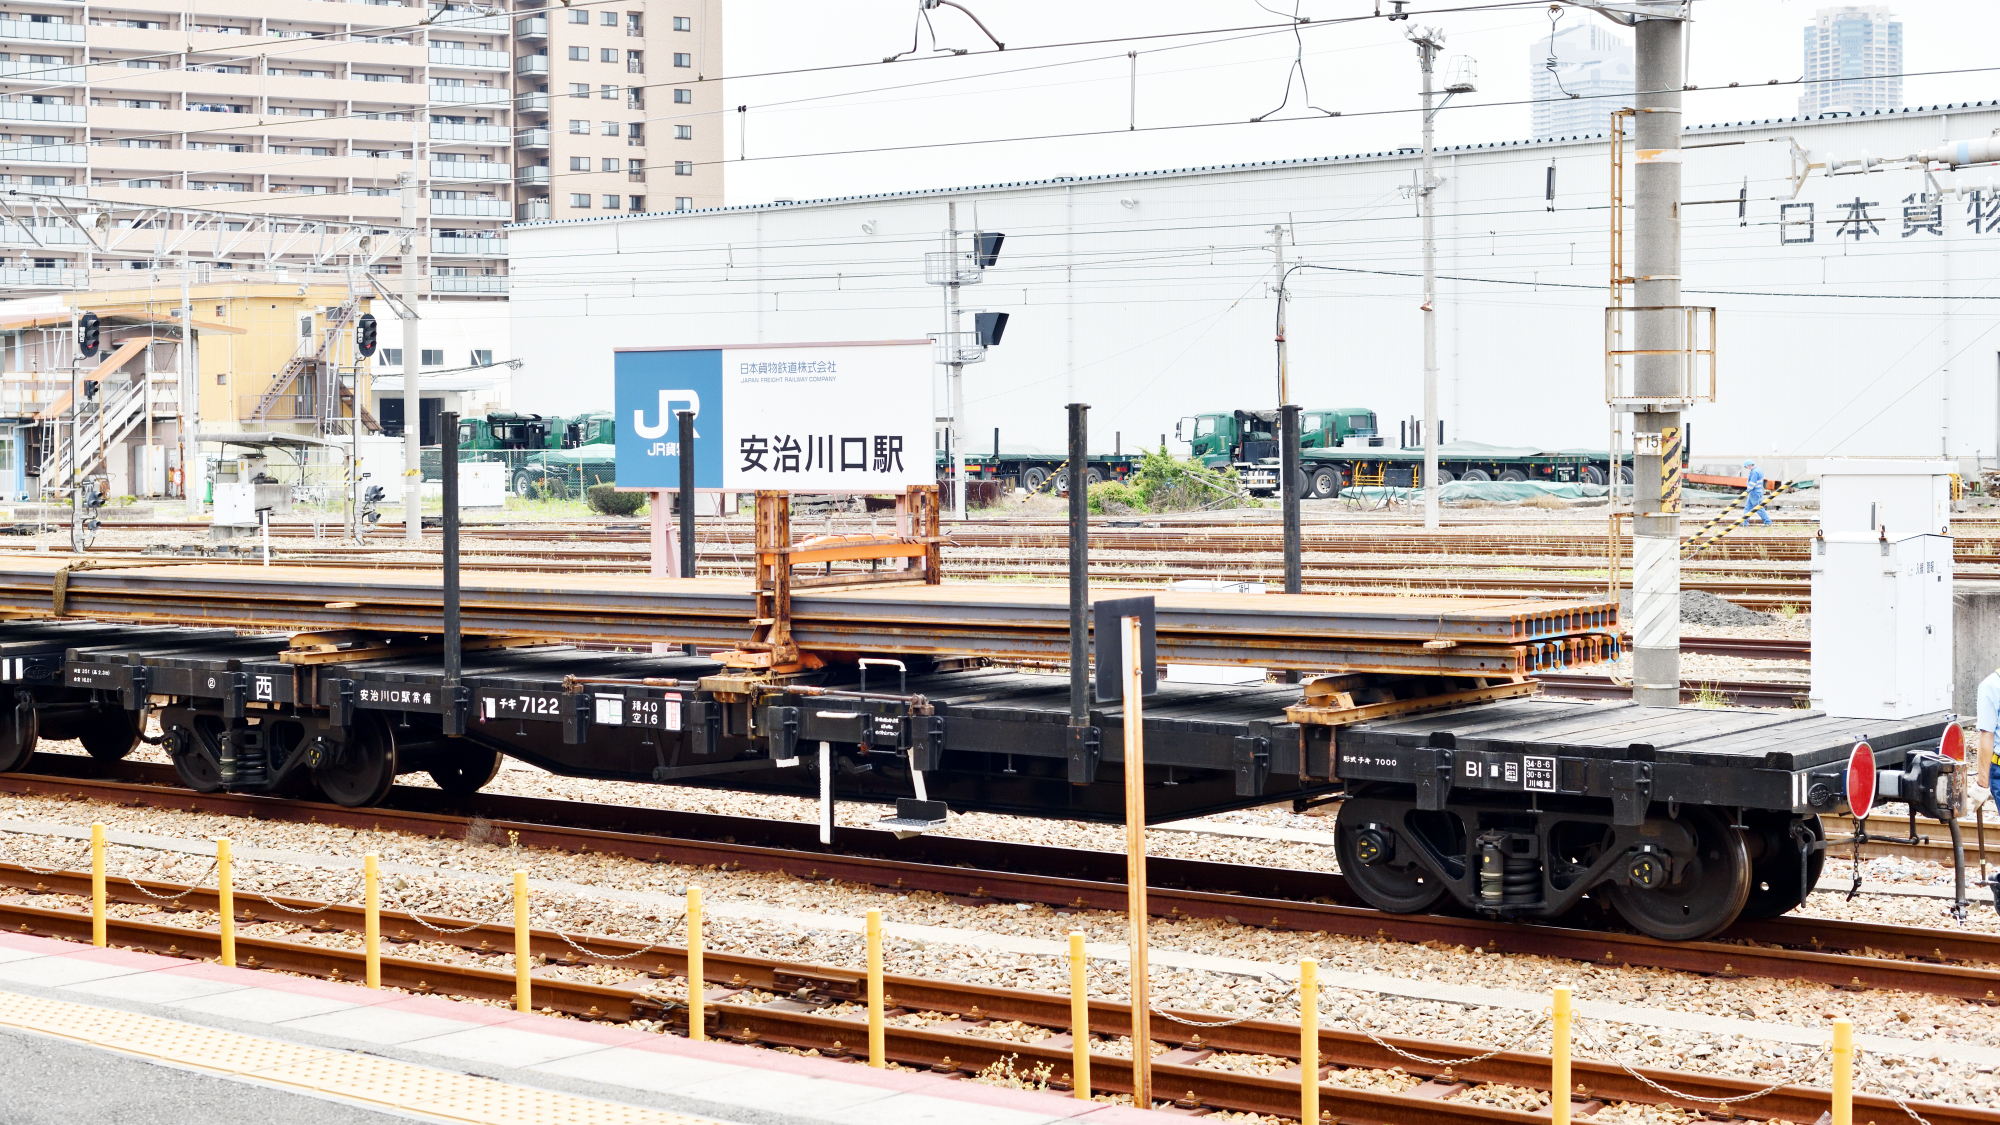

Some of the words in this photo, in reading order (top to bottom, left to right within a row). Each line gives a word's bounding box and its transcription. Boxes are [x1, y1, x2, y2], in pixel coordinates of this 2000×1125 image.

[634, 390, 700, 439] JR
[740, 435, 904, 474] 安治川口駅
[255, 675, 272, 701] 西
[519, 695, 560, 714] 7122
[1374, 758, 1397, 767] 7000
